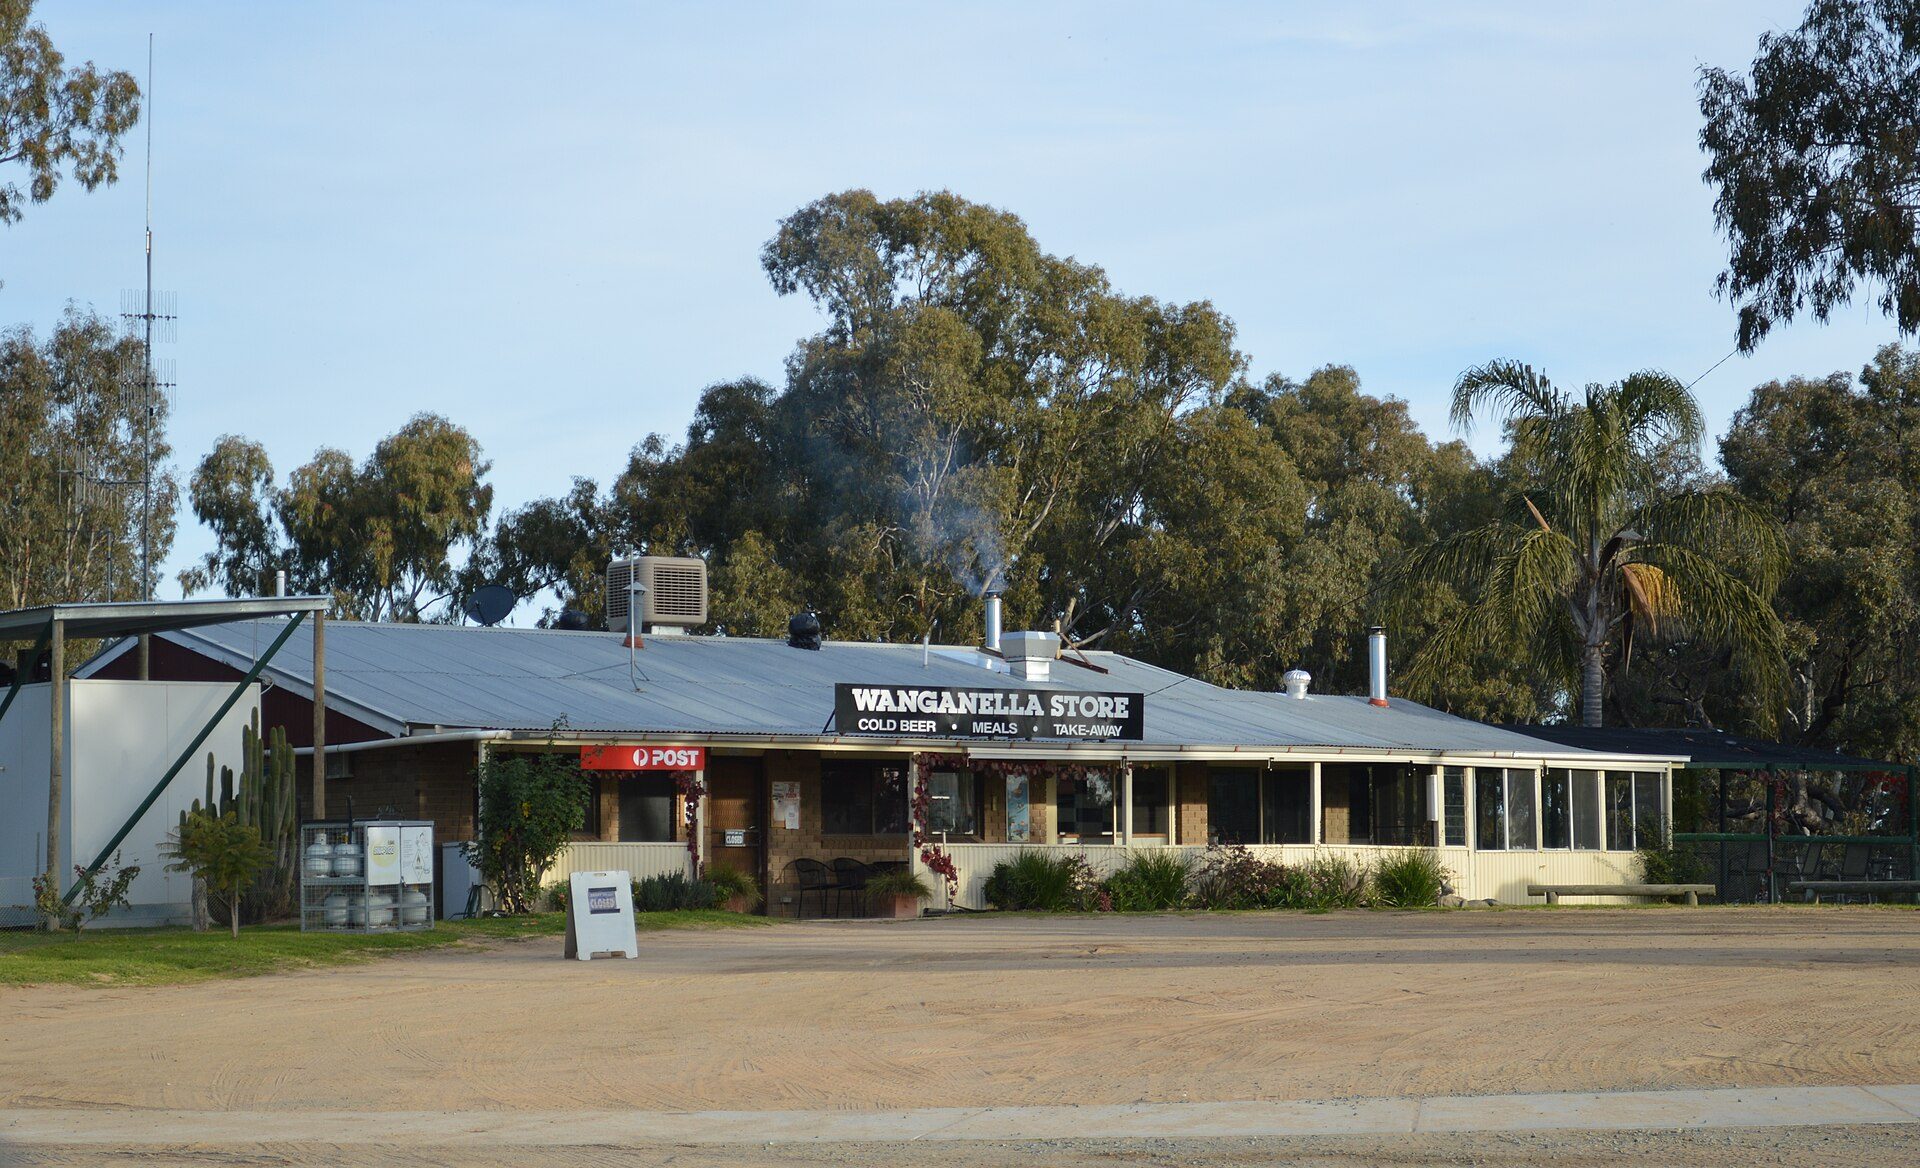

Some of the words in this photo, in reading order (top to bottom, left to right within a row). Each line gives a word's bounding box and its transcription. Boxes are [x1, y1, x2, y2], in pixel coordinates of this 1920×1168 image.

[852, 688, 1044, 716] WANGANELLA
[1050, 695, 1129, 718] STORE
[858, 718, 897, 731] COLD
[900, 720, 936, 732] BEER
[972, 722, 1018, 734] MEALS
[1053, 724, 1122, 736] TAKE-AWAY
[652, 750, 699, 766] POST
[590, 898, 615, 909] CLOSED
